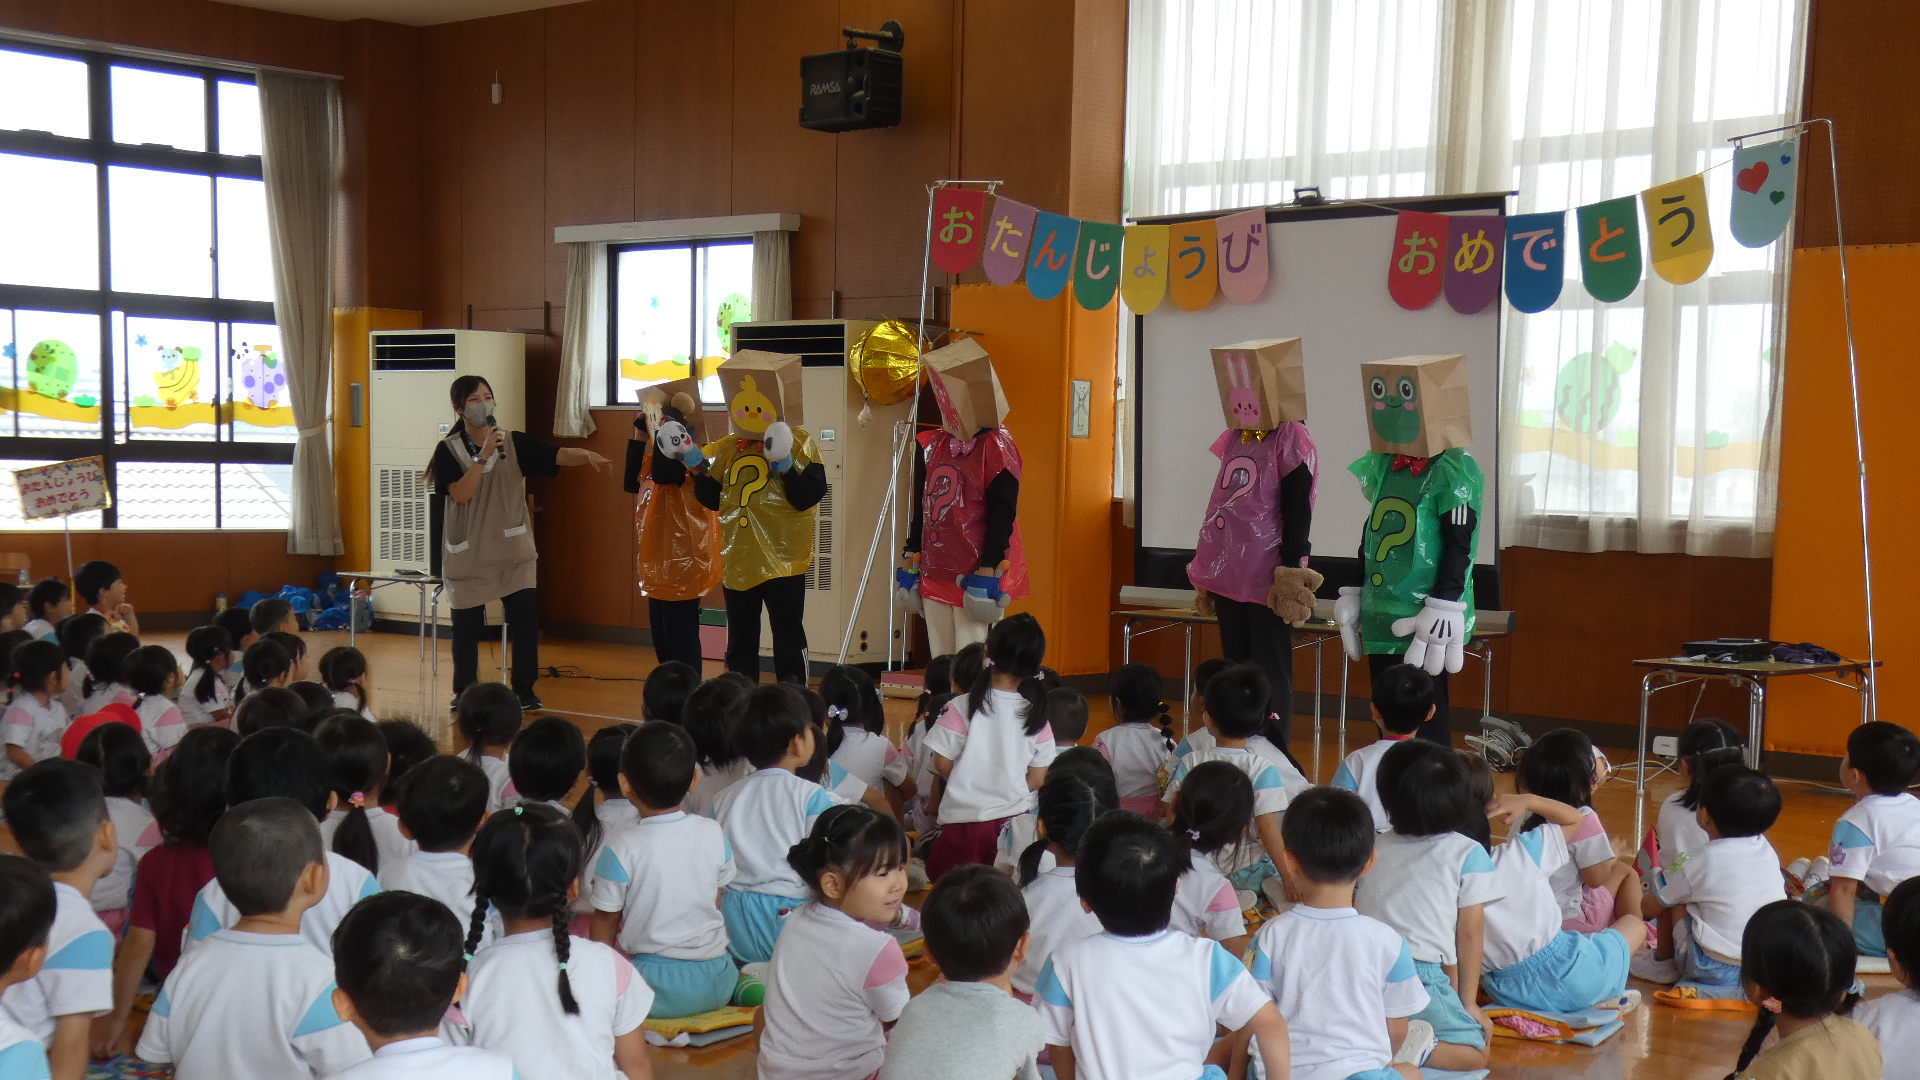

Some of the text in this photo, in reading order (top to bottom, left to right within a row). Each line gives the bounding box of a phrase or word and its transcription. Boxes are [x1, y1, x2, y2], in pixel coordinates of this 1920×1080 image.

[810, 81, 841, 96] RAMSA
[939, 194, 1696, 281] おたんじょうび おめでとう
[35, 488, 90, 508] おめでとう
[728, 453, 770, 529] ?
[1370, 495, 1417, 587] ?
